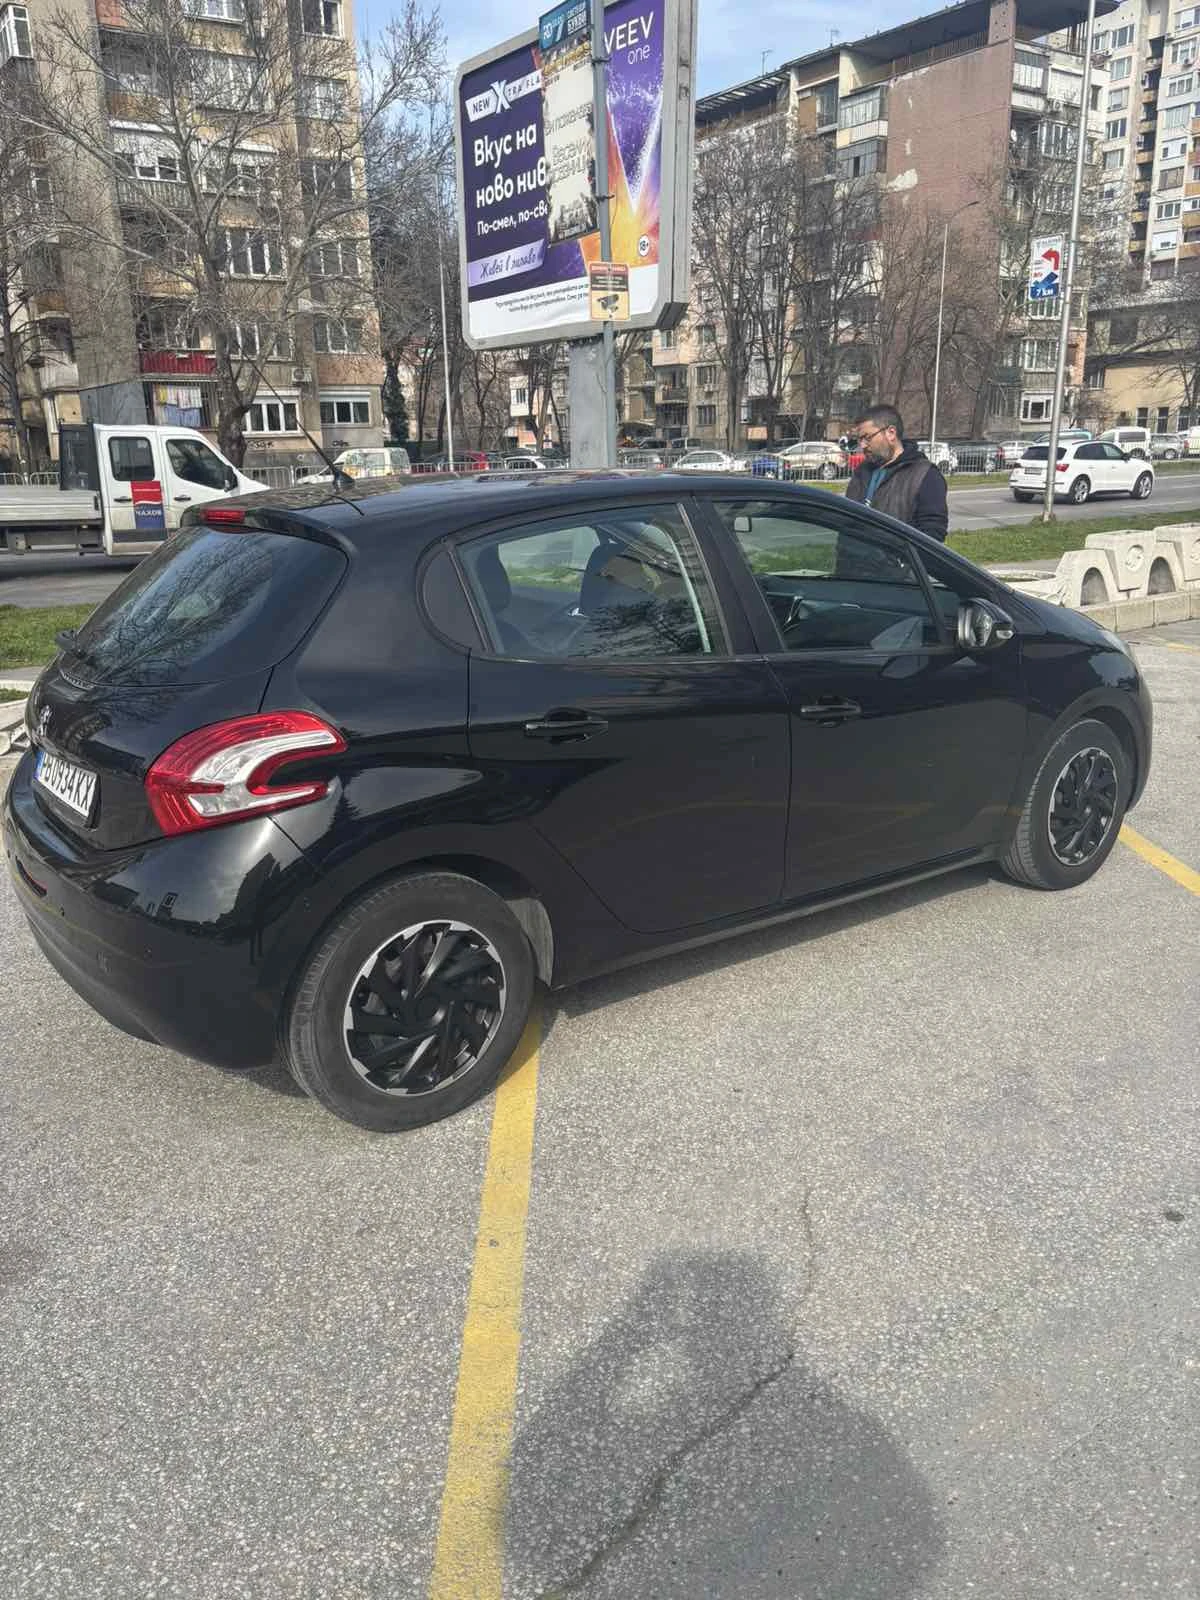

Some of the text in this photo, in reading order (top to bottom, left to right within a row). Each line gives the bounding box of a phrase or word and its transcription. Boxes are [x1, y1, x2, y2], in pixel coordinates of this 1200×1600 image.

[604, 10, 654, 54] VEEV
[627, 44, 650, 65] one
[472, 97, 490, 114] NEW
[474, 123, 537, 168] Вкус на
[476, 173, 514, 209] ново
[517, 156, 547, 194] нив
[477, 215, 517, 236] По-смел,
